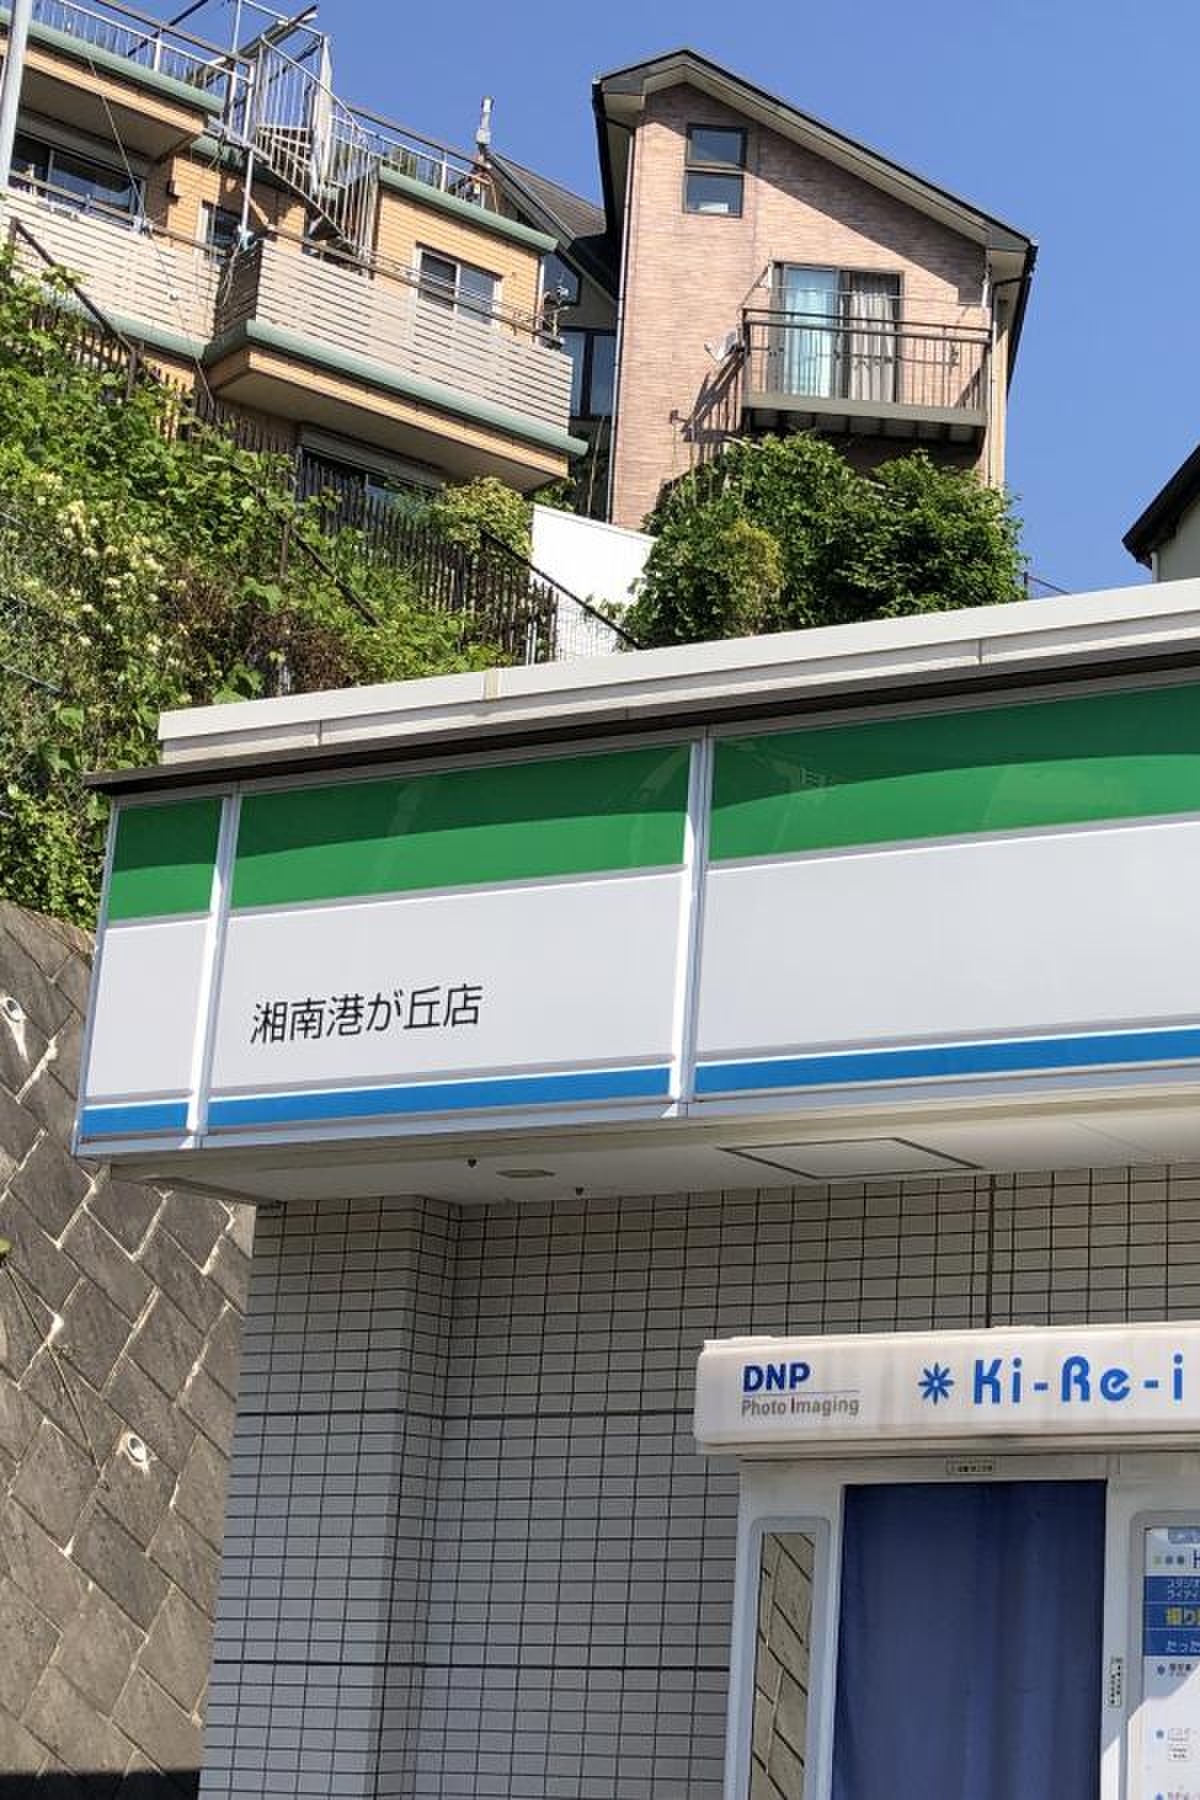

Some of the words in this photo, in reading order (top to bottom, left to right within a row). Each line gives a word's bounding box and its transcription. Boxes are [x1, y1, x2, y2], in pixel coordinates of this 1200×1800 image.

[250, 983, 483, 1044] 湘南港が丘店
[742, 1361, 811, 1392] DNP
[971, 1352, 1185, 1406] Ki-Re-i
[740, 1399, 790, 1418] Photo
[791, 1396, 860, 1417] Imaging
